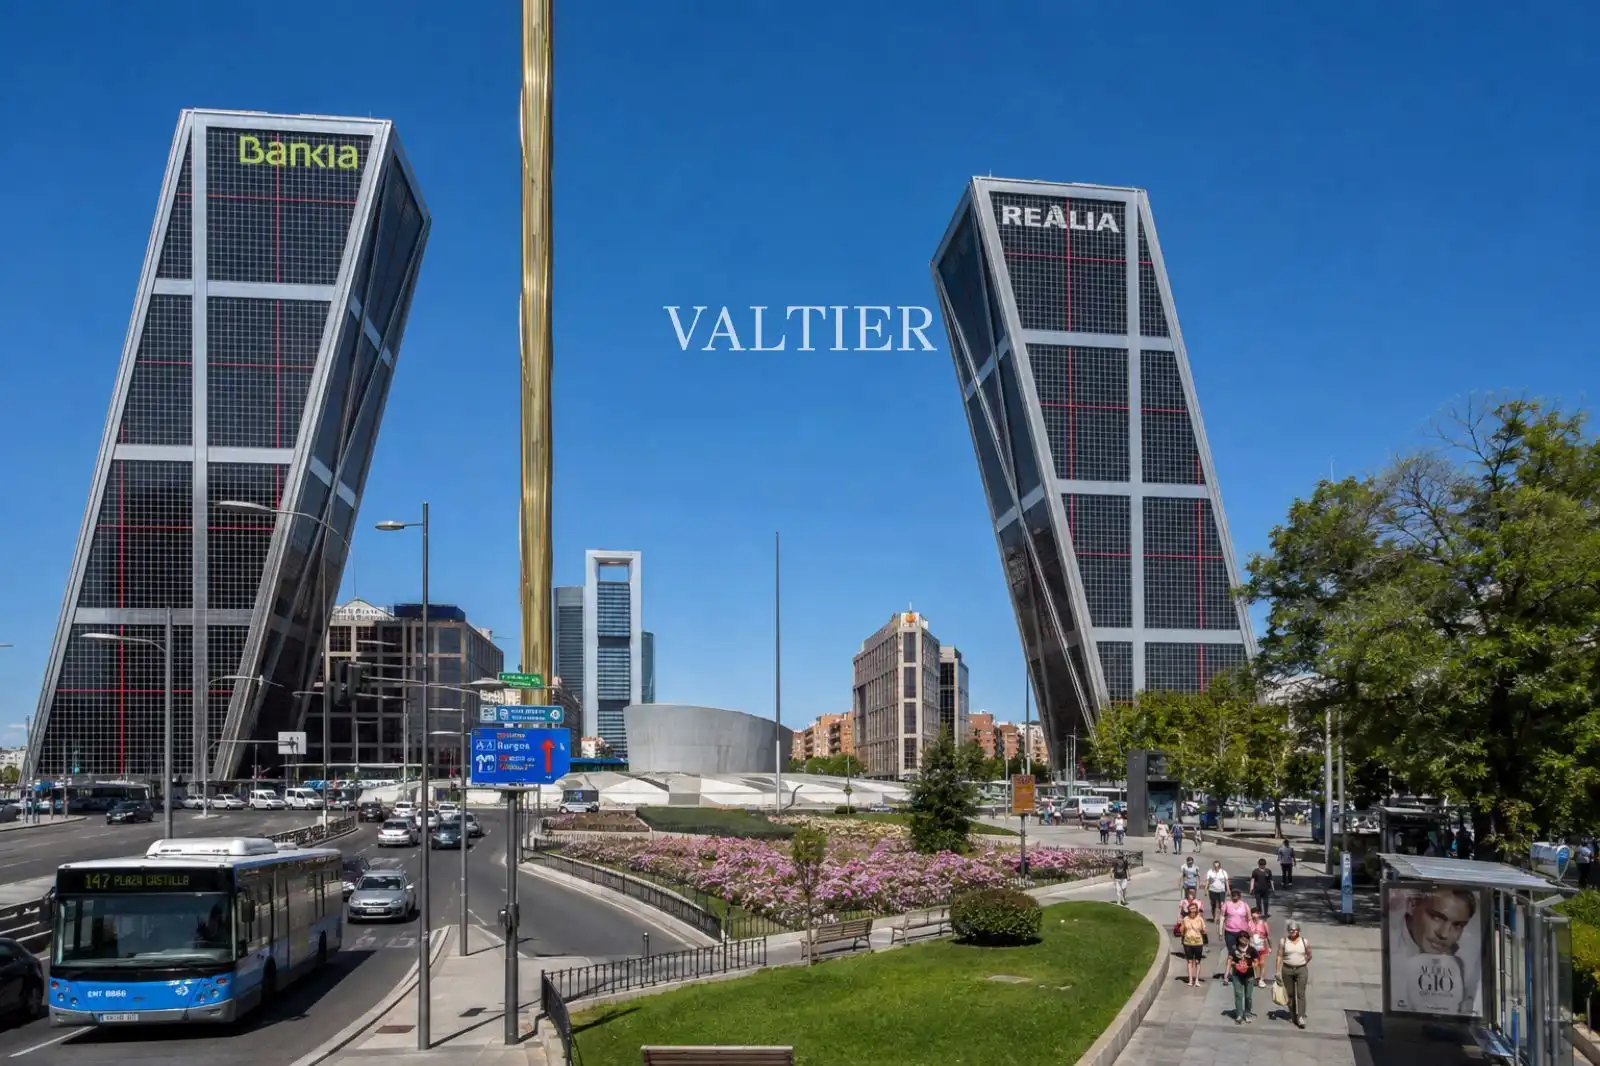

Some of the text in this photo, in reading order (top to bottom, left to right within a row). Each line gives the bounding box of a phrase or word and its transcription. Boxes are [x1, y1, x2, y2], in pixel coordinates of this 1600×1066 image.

[239, 135, 359, 169] Bankia
[1002, 205, 1120, 233] REALIA
[85, 873, 111, 889] 147
